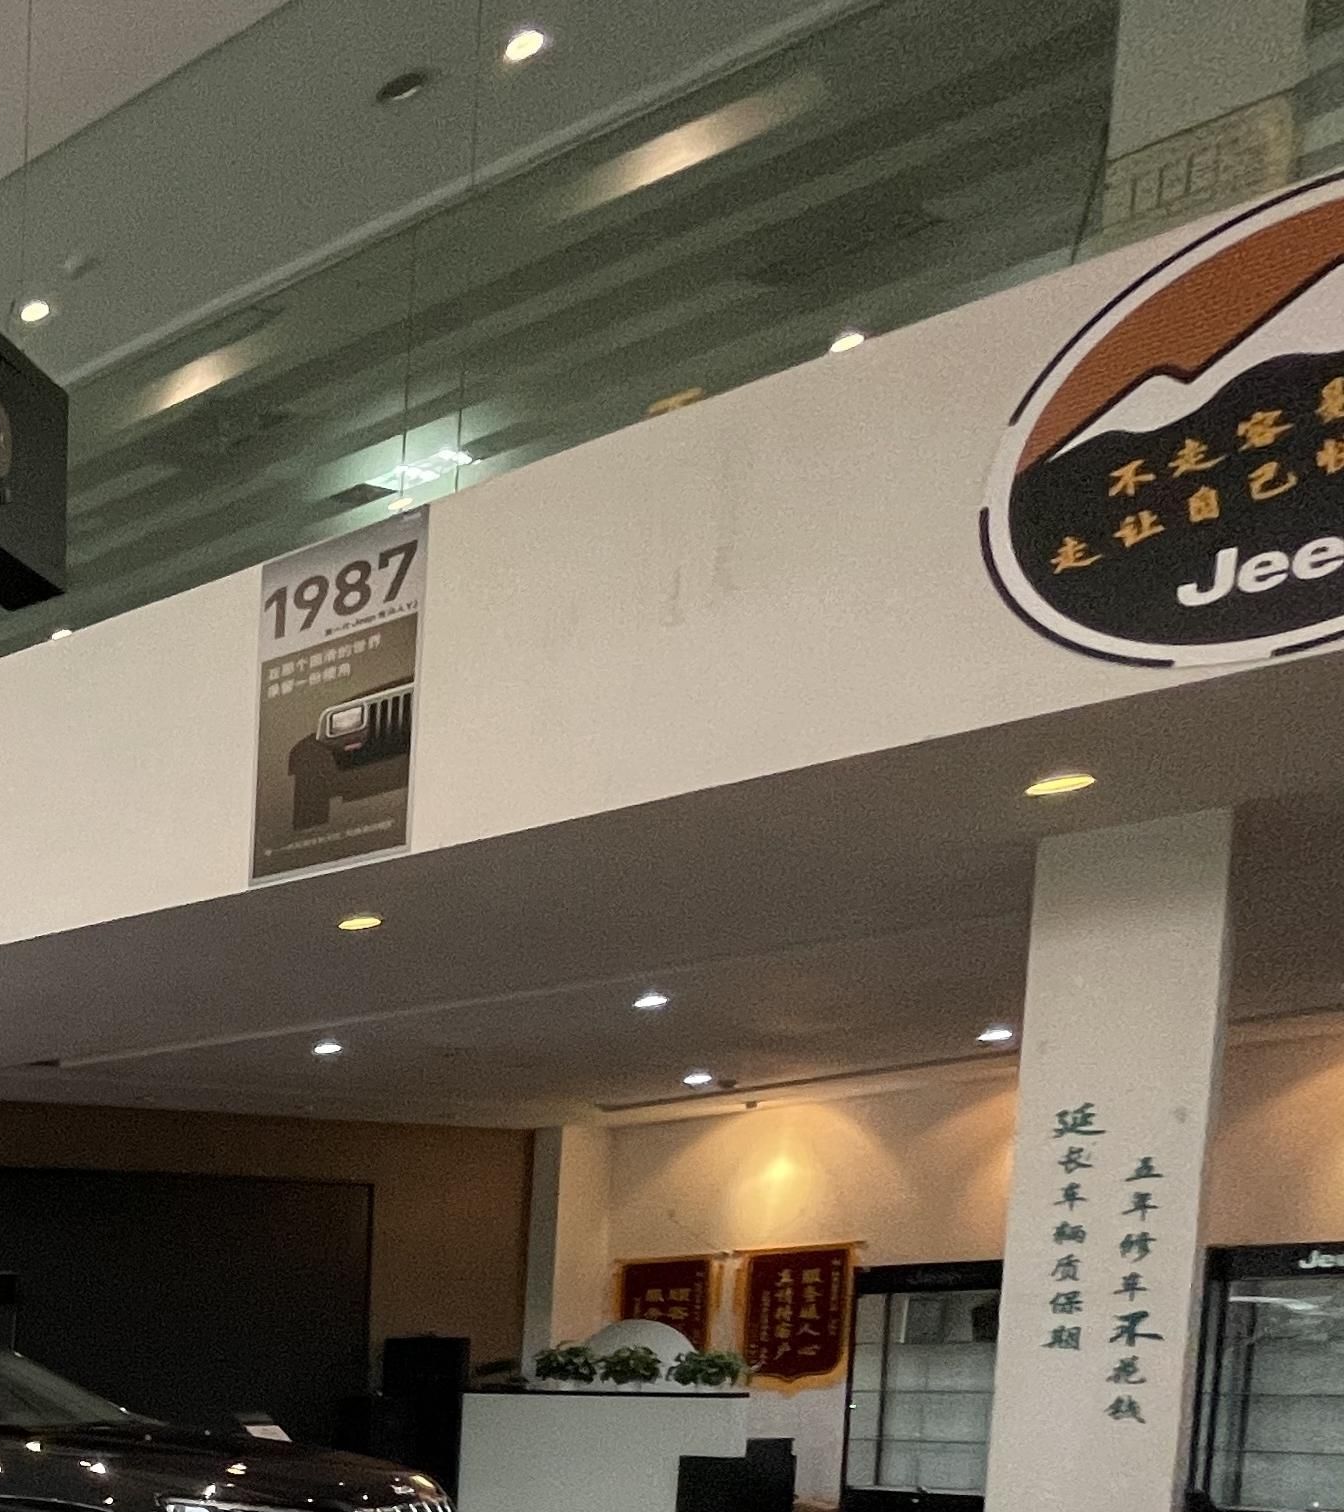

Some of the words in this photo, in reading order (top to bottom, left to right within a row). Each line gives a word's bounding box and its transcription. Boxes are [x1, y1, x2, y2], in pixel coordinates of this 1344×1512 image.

[263, 539, 419, 641] 1987
[1177, 535, 1344, 606] Jee
[1040, 1102, 1107, 1351] 延长车辆质保期
[1103, 1155, 1165, 1425] 五年修车不花钱
